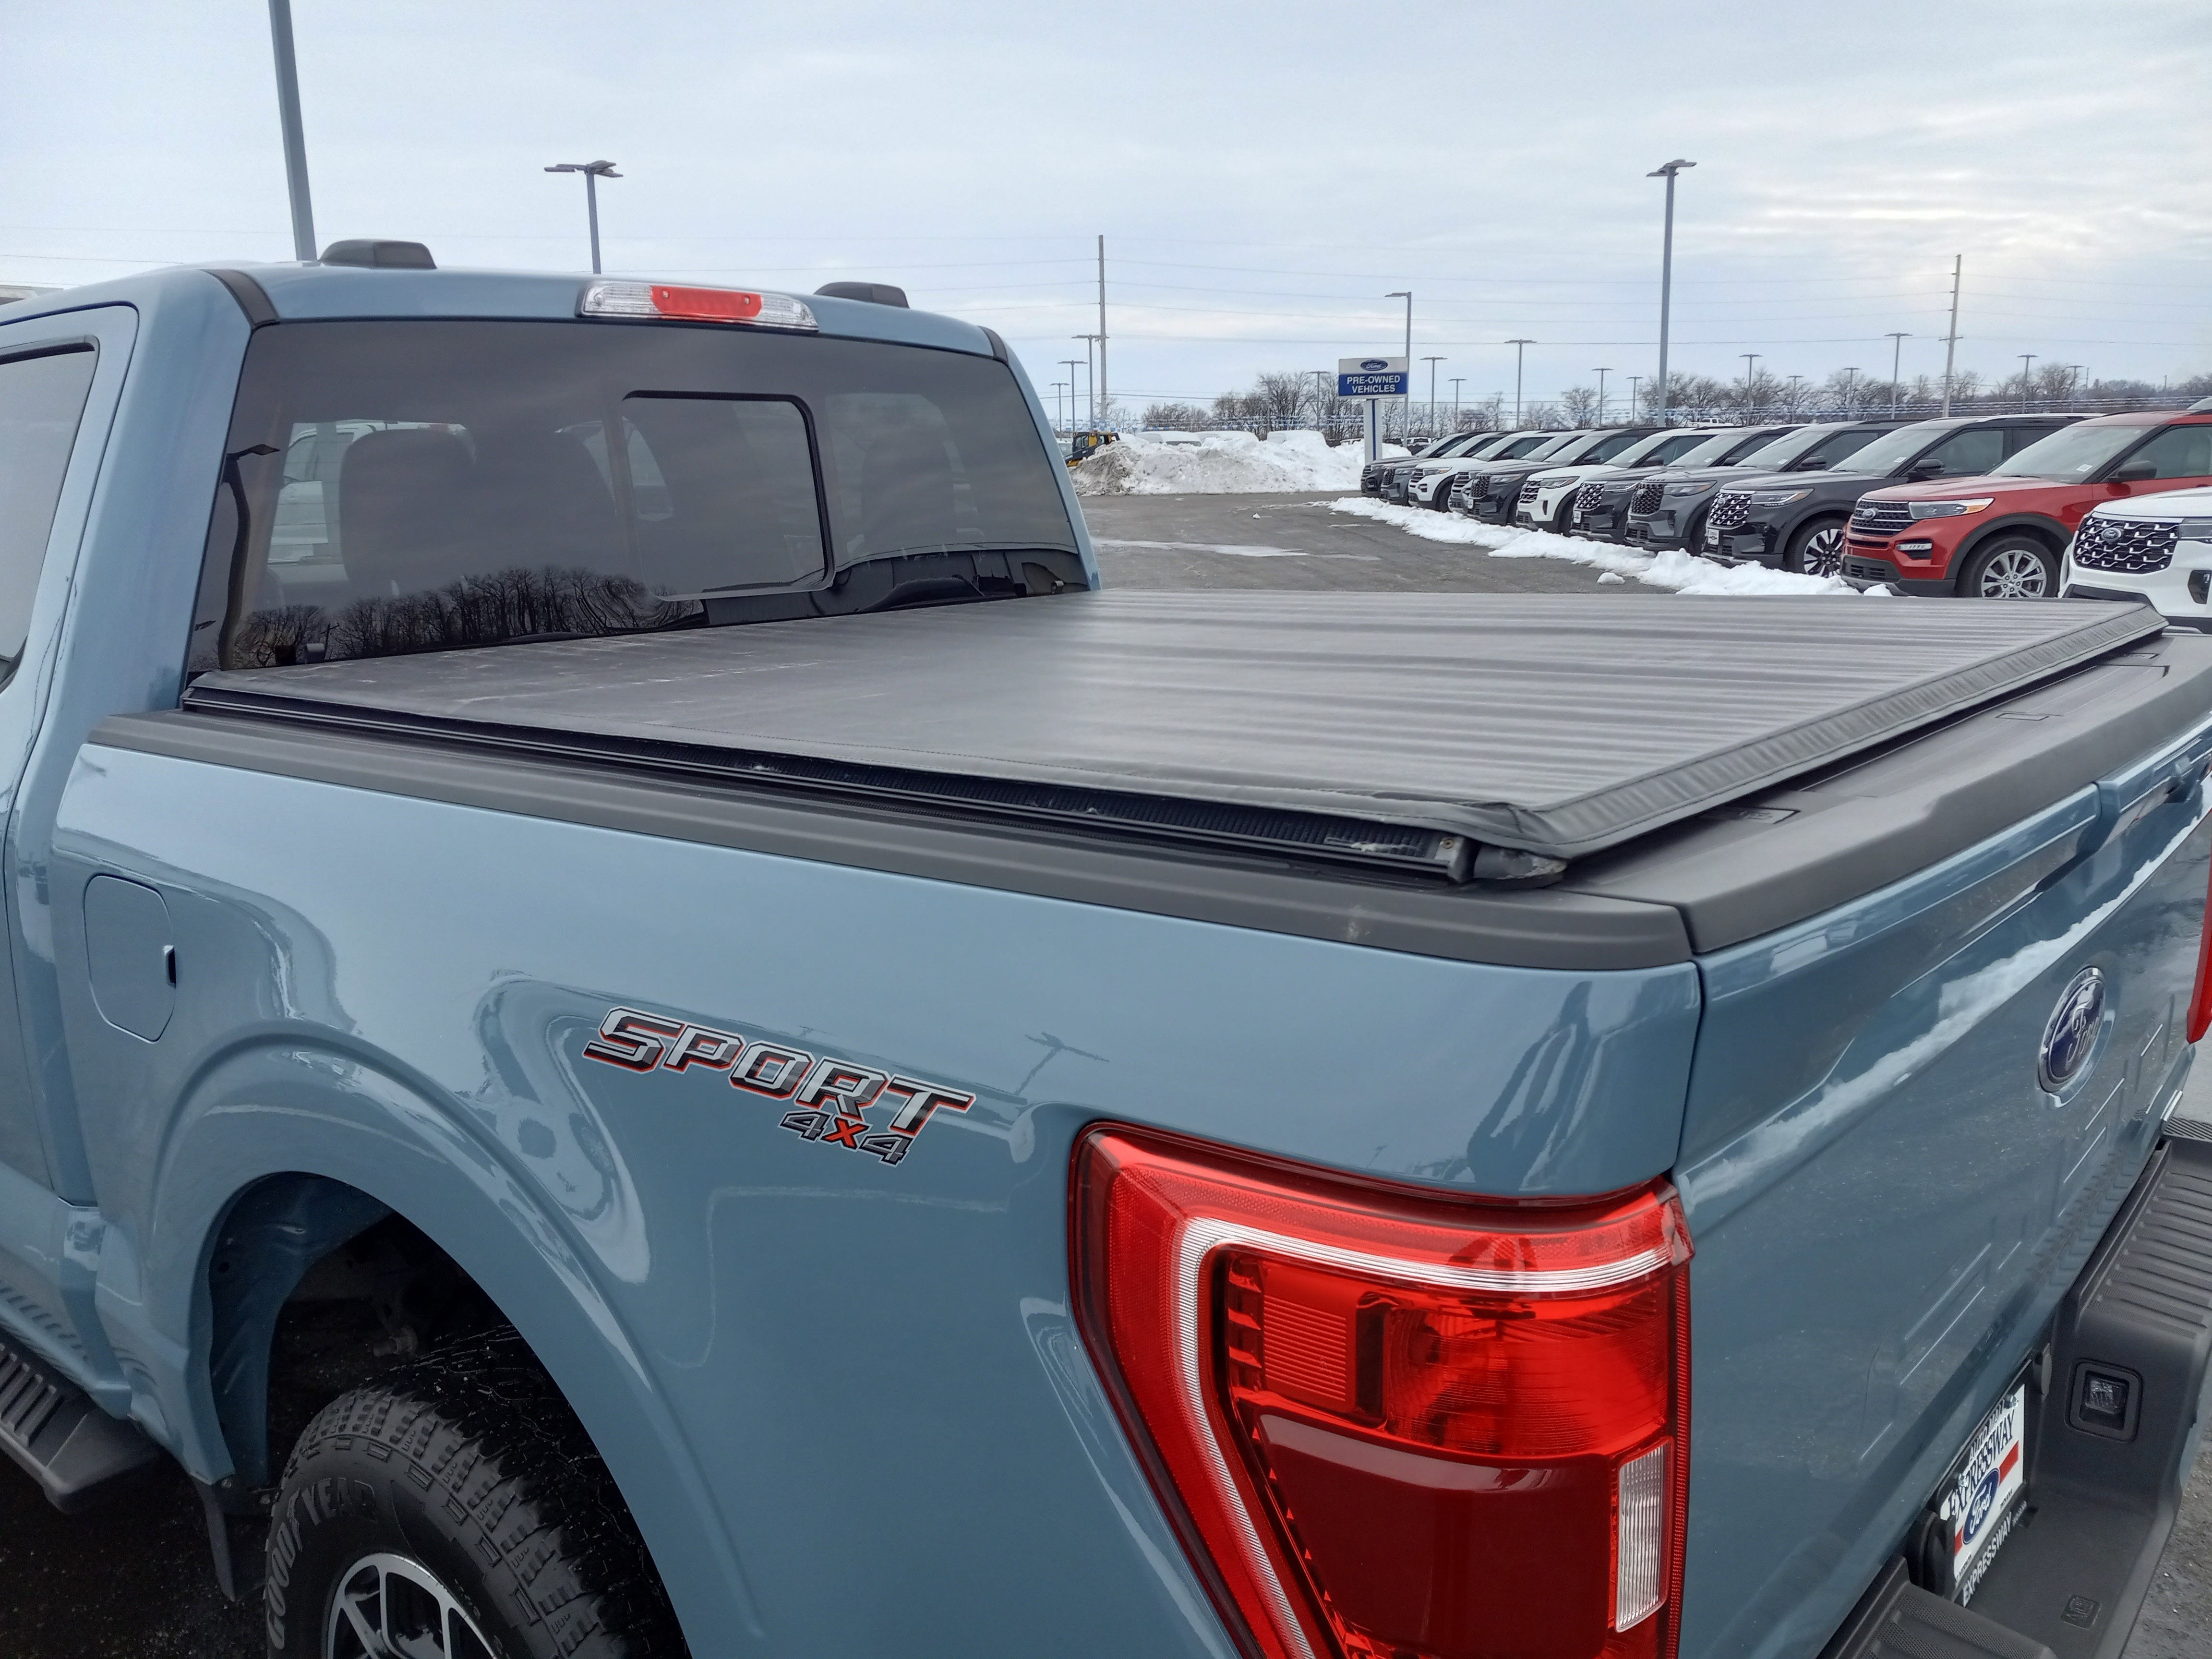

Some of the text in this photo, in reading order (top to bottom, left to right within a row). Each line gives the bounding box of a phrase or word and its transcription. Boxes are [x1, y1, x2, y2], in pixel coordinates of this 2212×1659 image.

[1346, 375, 1401, 385] PRE-OWNED
[1352, 384, 1395, 394] VEHICLES
[2065, 1004, 2099, 1071] Ford
[582, 1006, 976, 1137] SPORT
[1948, 1409, 2015, 1522] EXPRESSWAY
[1970, 1482, 1993, 1535] Ford
[1963, 1511, 2012, 1608] EXPRESSWAY
